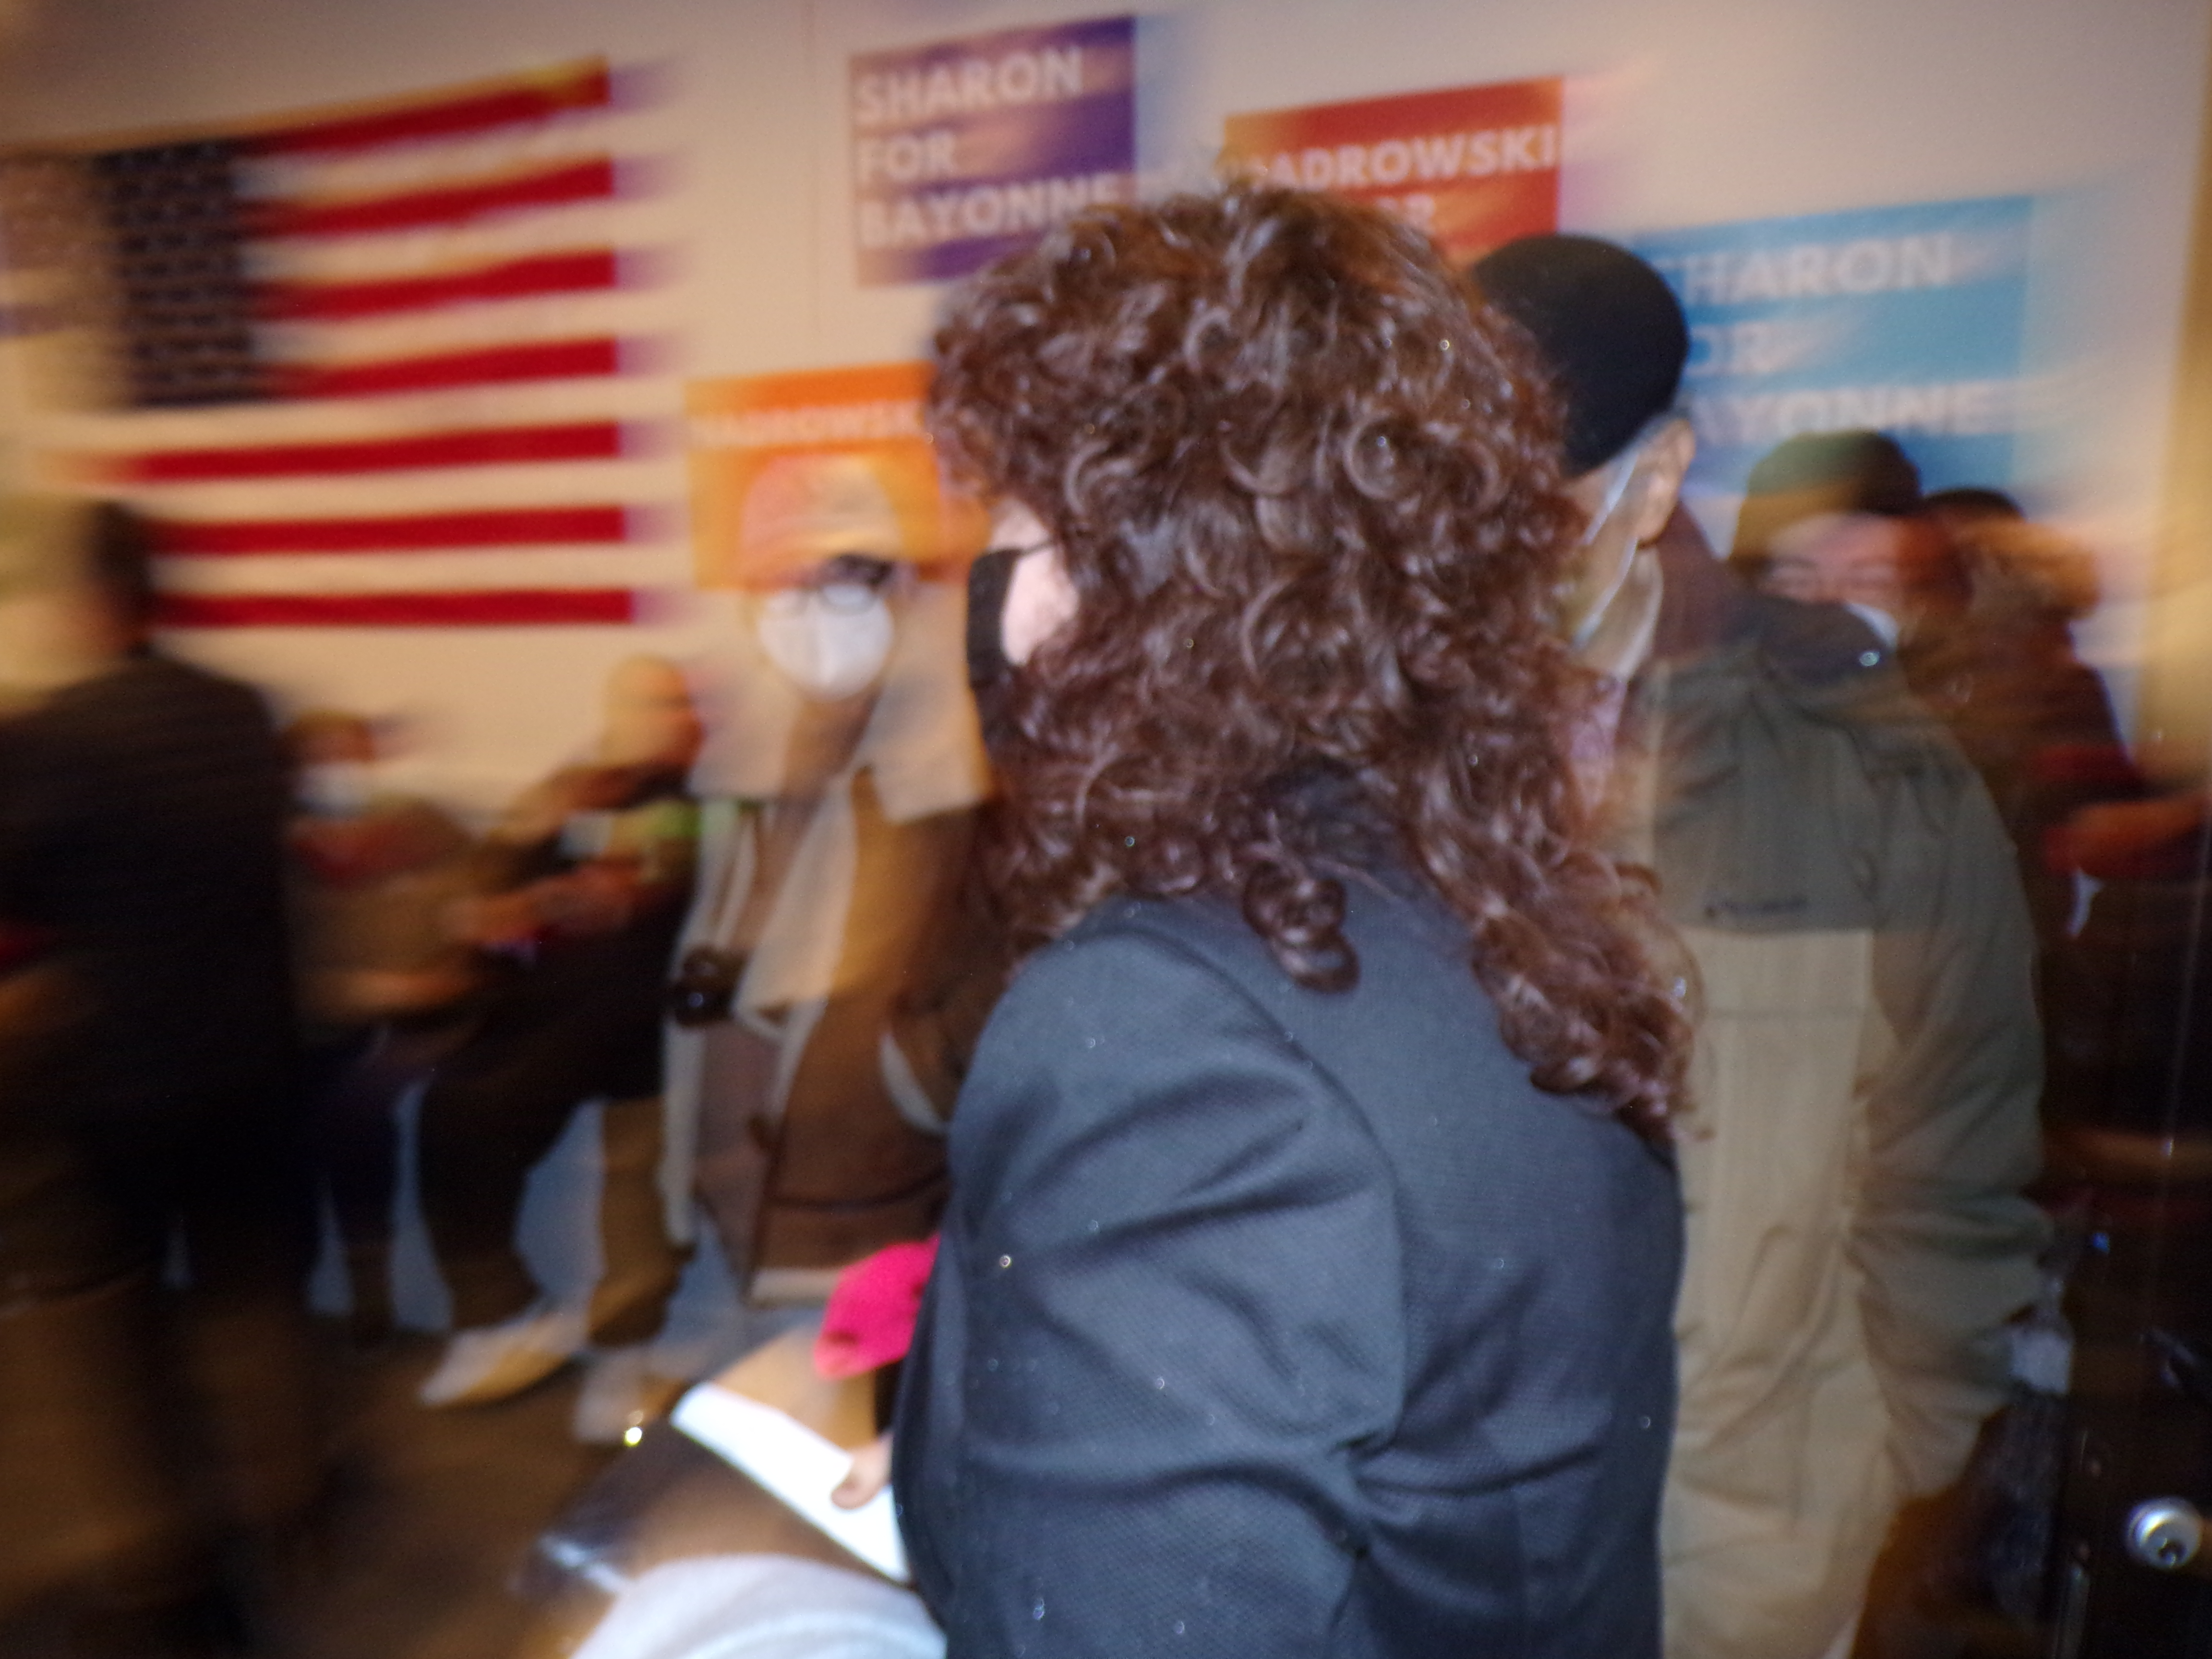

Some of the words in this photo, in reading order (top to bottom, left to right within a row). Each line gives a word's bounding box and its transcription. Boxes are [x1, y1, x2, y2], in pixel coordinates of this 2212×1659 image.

[855, 46, 1083, 127] SHARON
[857, 130, 956, 185] FOR
[1650, 232, 1953, 306] HARON
